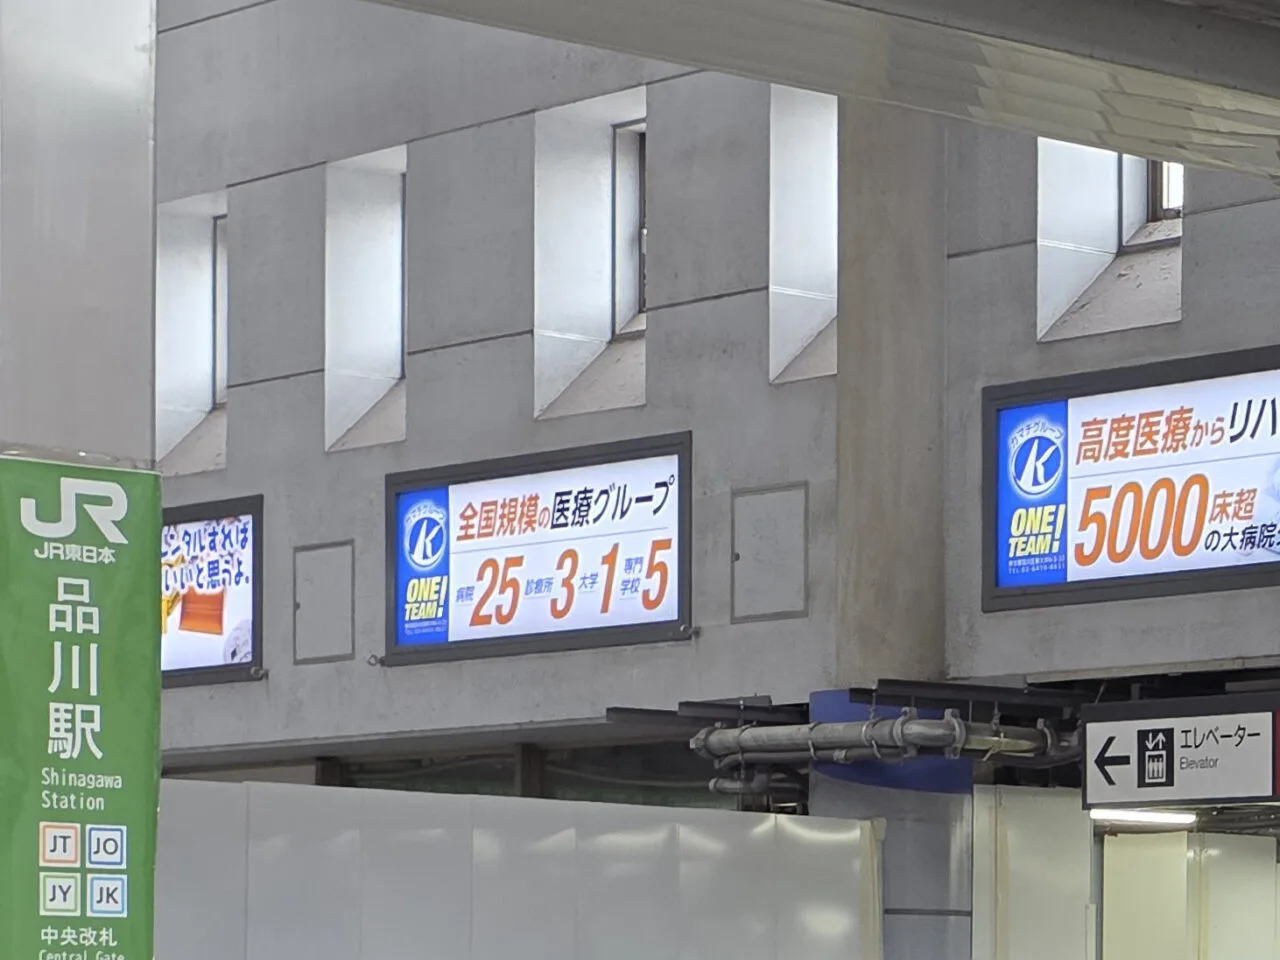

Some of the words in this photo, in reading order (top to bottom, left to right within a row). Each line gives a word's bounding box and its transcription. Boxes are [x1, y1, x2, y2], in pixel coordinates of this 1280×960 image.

[20, 477, 129, 544] JR
[456, 473, 677, 542] 全国規模の医療グループ
[1074, 473, 1210, 568] 5000
[1208, 488, 1258, 522] 床超
[34, 541, 116, 565] JR東日本
[469, 555, 524, 627] 25
[550, 548, 579, 619] 3
[578, 573, 599, 590] 大学
[600, 542, 619, 614] 1
[624, 556, 644, 575] 専門
[641, 538, 673, 611] 5
[48, 577, 103, 760] 品川駅
[1180, 723, 1261, 750] エレベーター
[1179, 754, 1219, 771] Elevator
[41, 768, 122, 790] Shinagawa
[41, 791, 105, 811] Station
[50, 835, 71, 854] JT
[93, 837, 119, 855] JO
[49, 884, 72, 903] JY
[96, 886, 119, 904] JK
[41, 925, 118, 947] 中央改札
